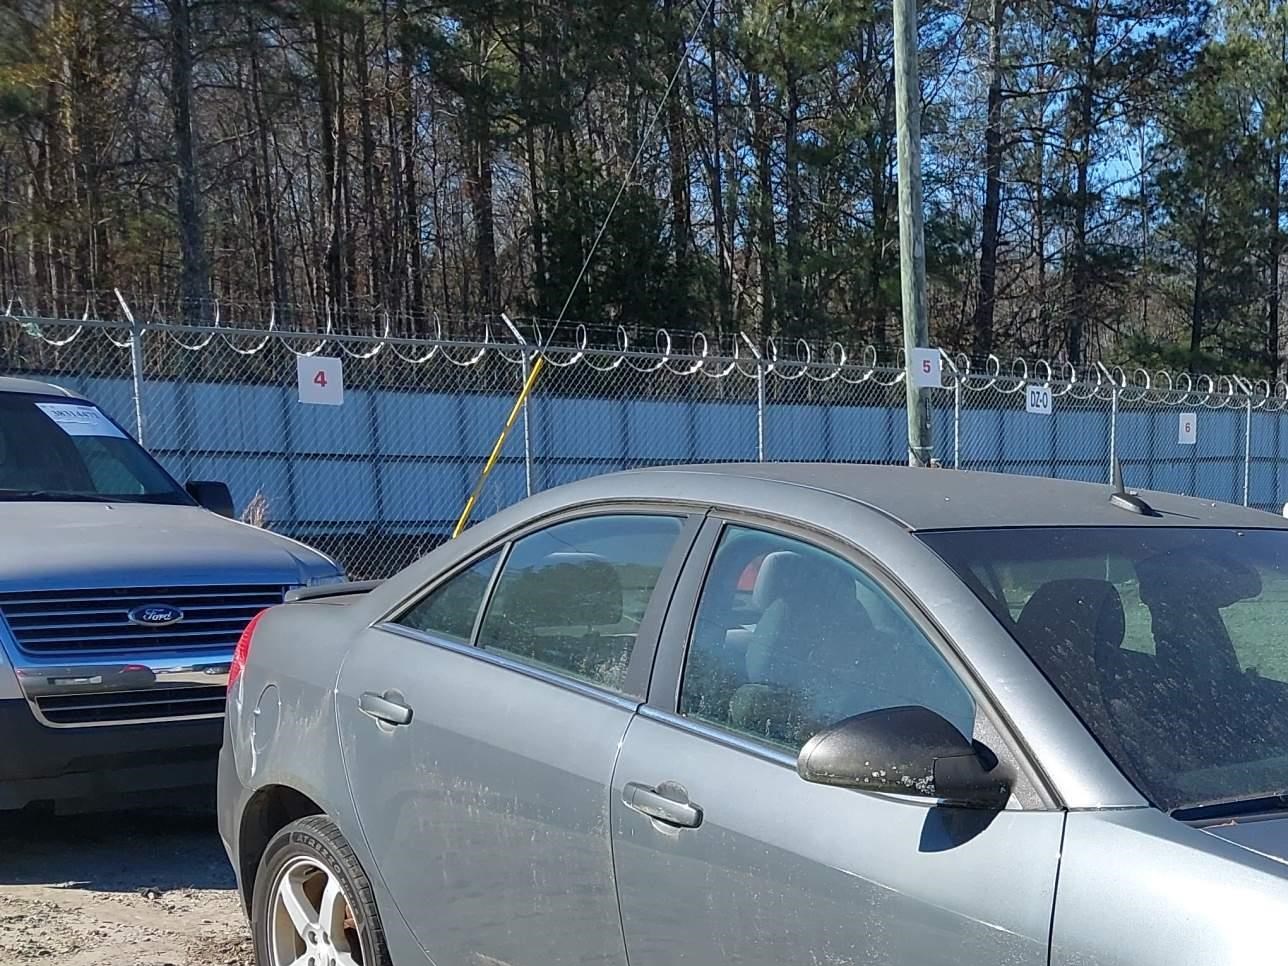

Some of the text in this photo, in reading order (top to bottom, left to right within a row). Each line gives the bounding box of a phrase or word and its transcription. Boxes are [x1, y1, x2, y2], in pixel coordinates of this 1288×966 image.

[922, 360, 931, 373] 5
[313, 371, 328, 387] 4
[1185, 422, 1191, 433] 6
[143, 608, 172, 621] Ford
